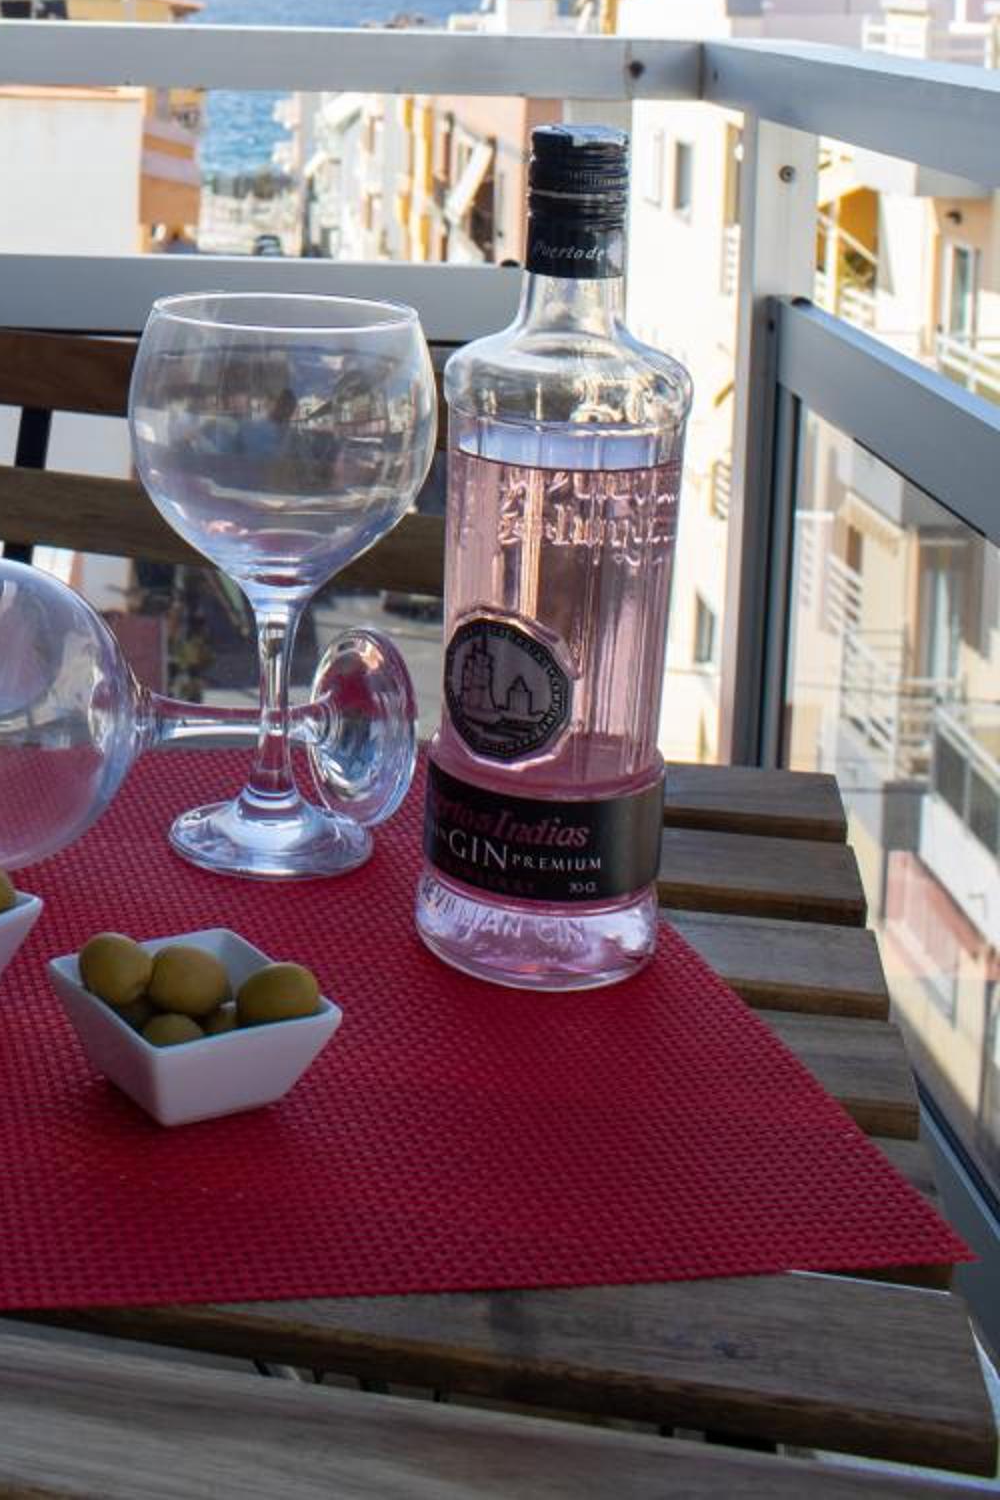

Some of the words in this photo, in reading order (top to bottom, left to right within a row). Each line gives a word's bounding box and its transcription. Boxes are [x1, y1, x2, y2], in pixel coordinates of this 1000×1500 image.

[492, 810, 590, 847] Indias
[449, 829, 508, 869] GIN
[512, 854, 601, 872] PREMIUM
